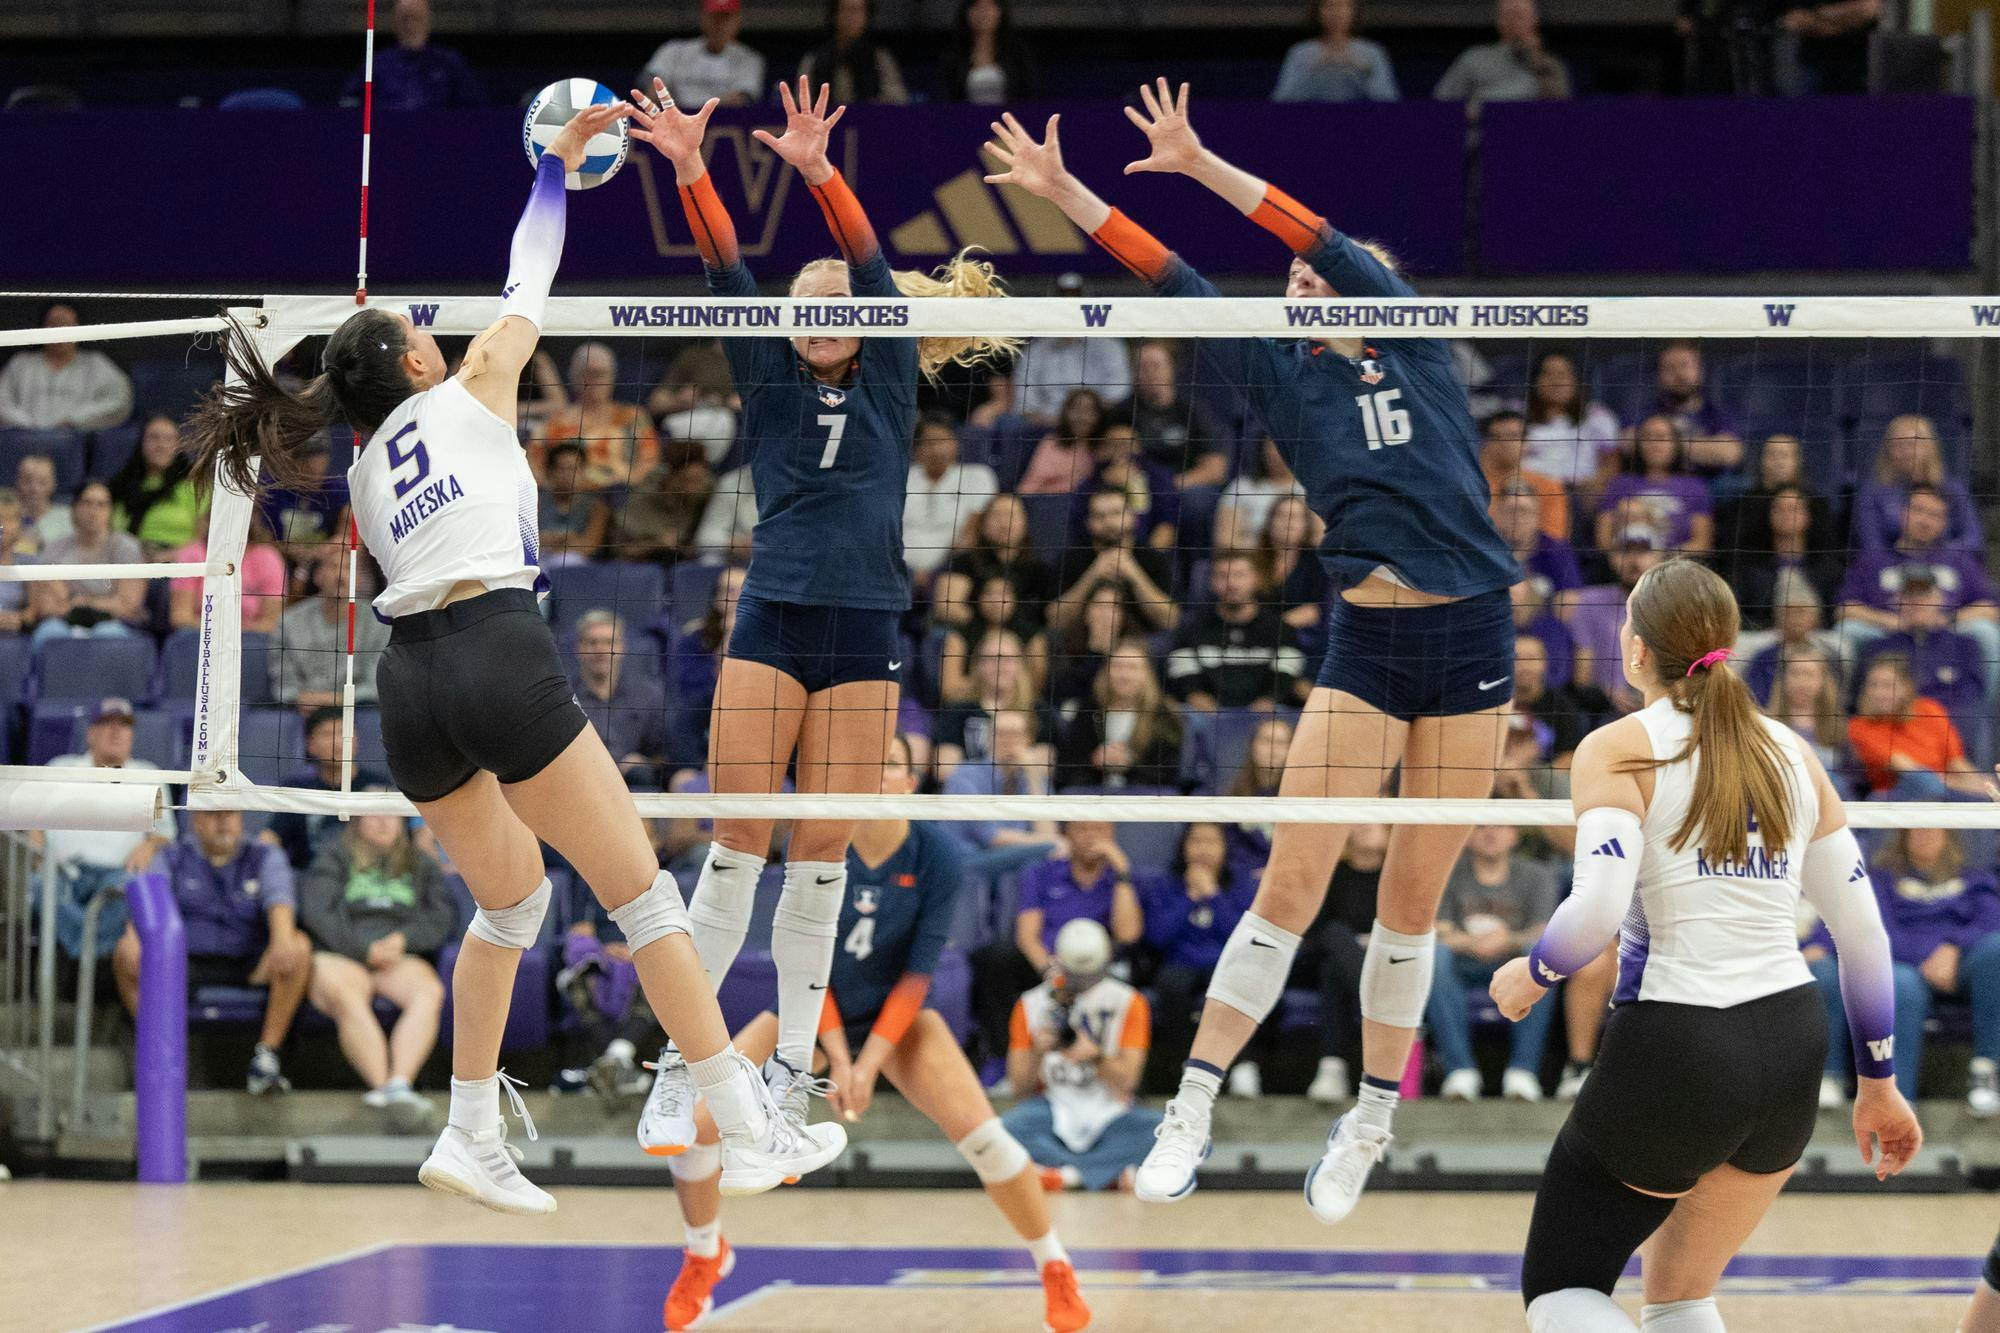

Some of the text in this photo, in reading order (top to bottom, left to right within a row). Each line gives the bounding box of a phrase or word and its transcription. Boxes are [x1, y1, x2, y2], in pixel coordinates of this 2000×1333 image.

[524, 100, 540, 161] molten
[408, 304, 440, 326] W
[609, 305, 908, 327] WASHINGTON HUSKIES
[1081, 304, 1112, 327] W
[1284, 305, 1588, 327] WASHINGTON HUSKIES
[1763, 304, 1796, 326] W
[1355, 388, 1412, 450] 16
[817, 414, 848, 468] 7
[385, 420, 430, 501] 5
[389, 474, 465, 544] MATESKA
[844, 916, 876, 961] 4
[1538, 958, 1567, 982] W
[1866, 1034, 1894, 1061] W
